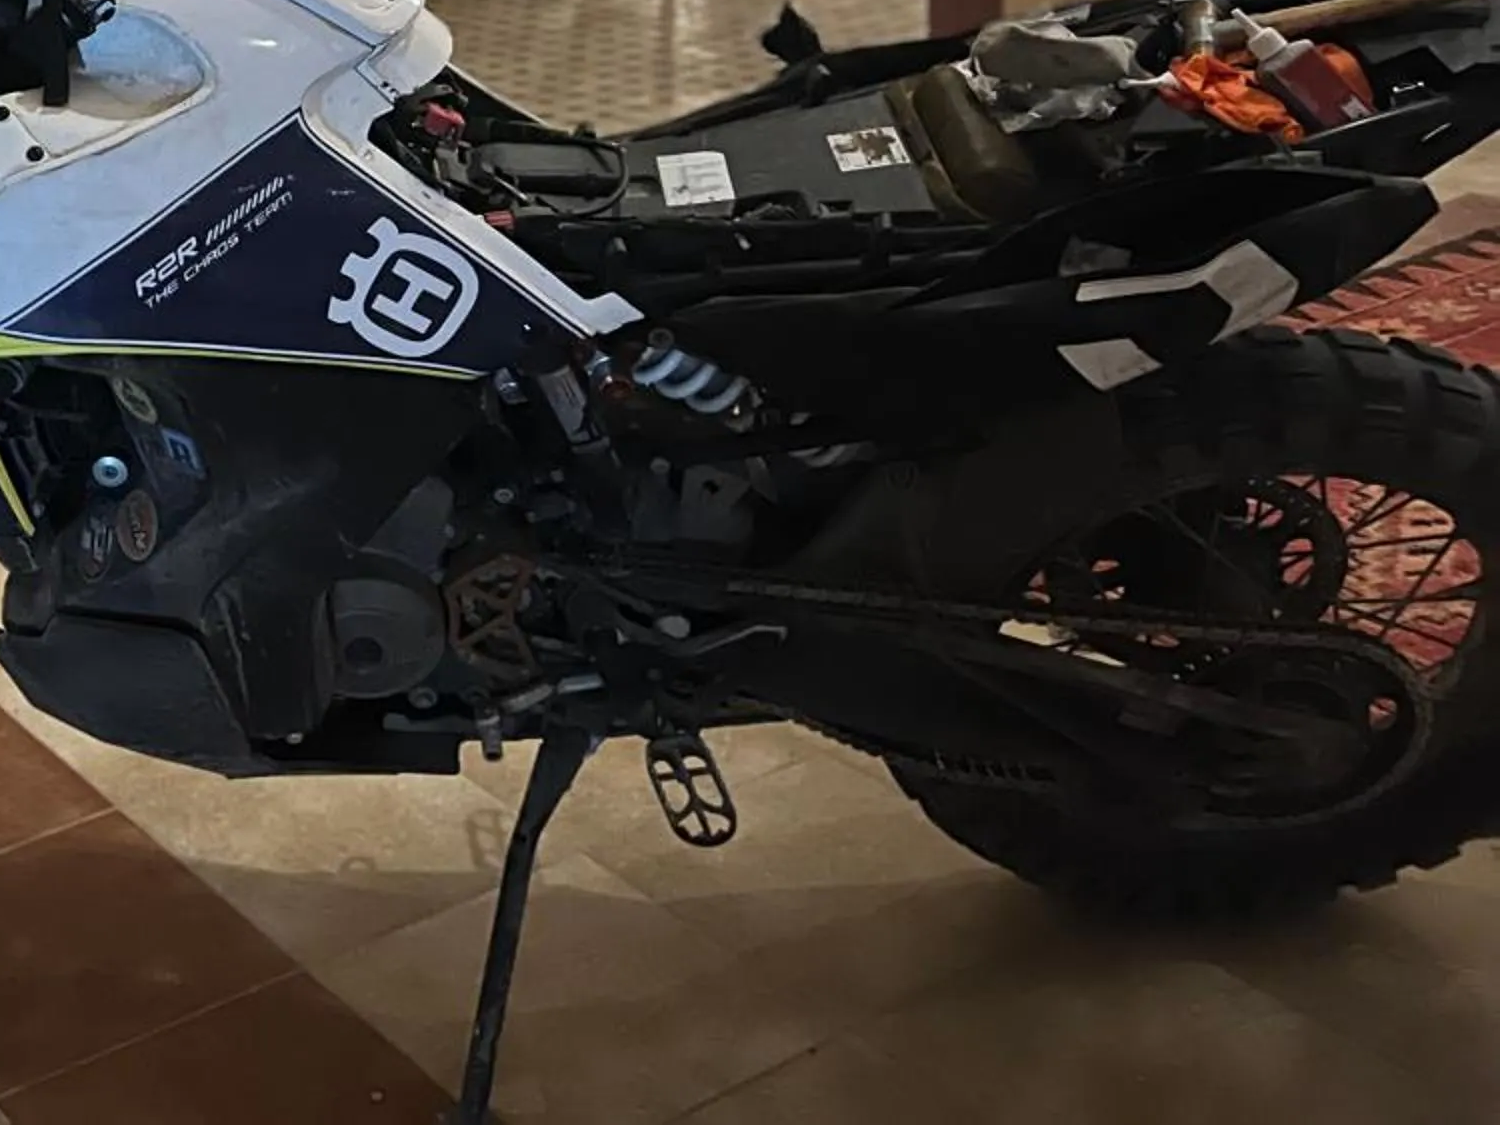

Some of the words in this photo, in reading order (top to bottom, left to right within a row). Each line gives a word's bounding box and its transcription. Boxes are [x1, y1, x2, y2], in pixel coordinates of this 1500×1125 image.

[135, 236, 198, 297] R2R
[145, 279, 179, 309] THE
[183, 232, 239, 282] CHAOS
[244, 191, 293, 232] TEAM
